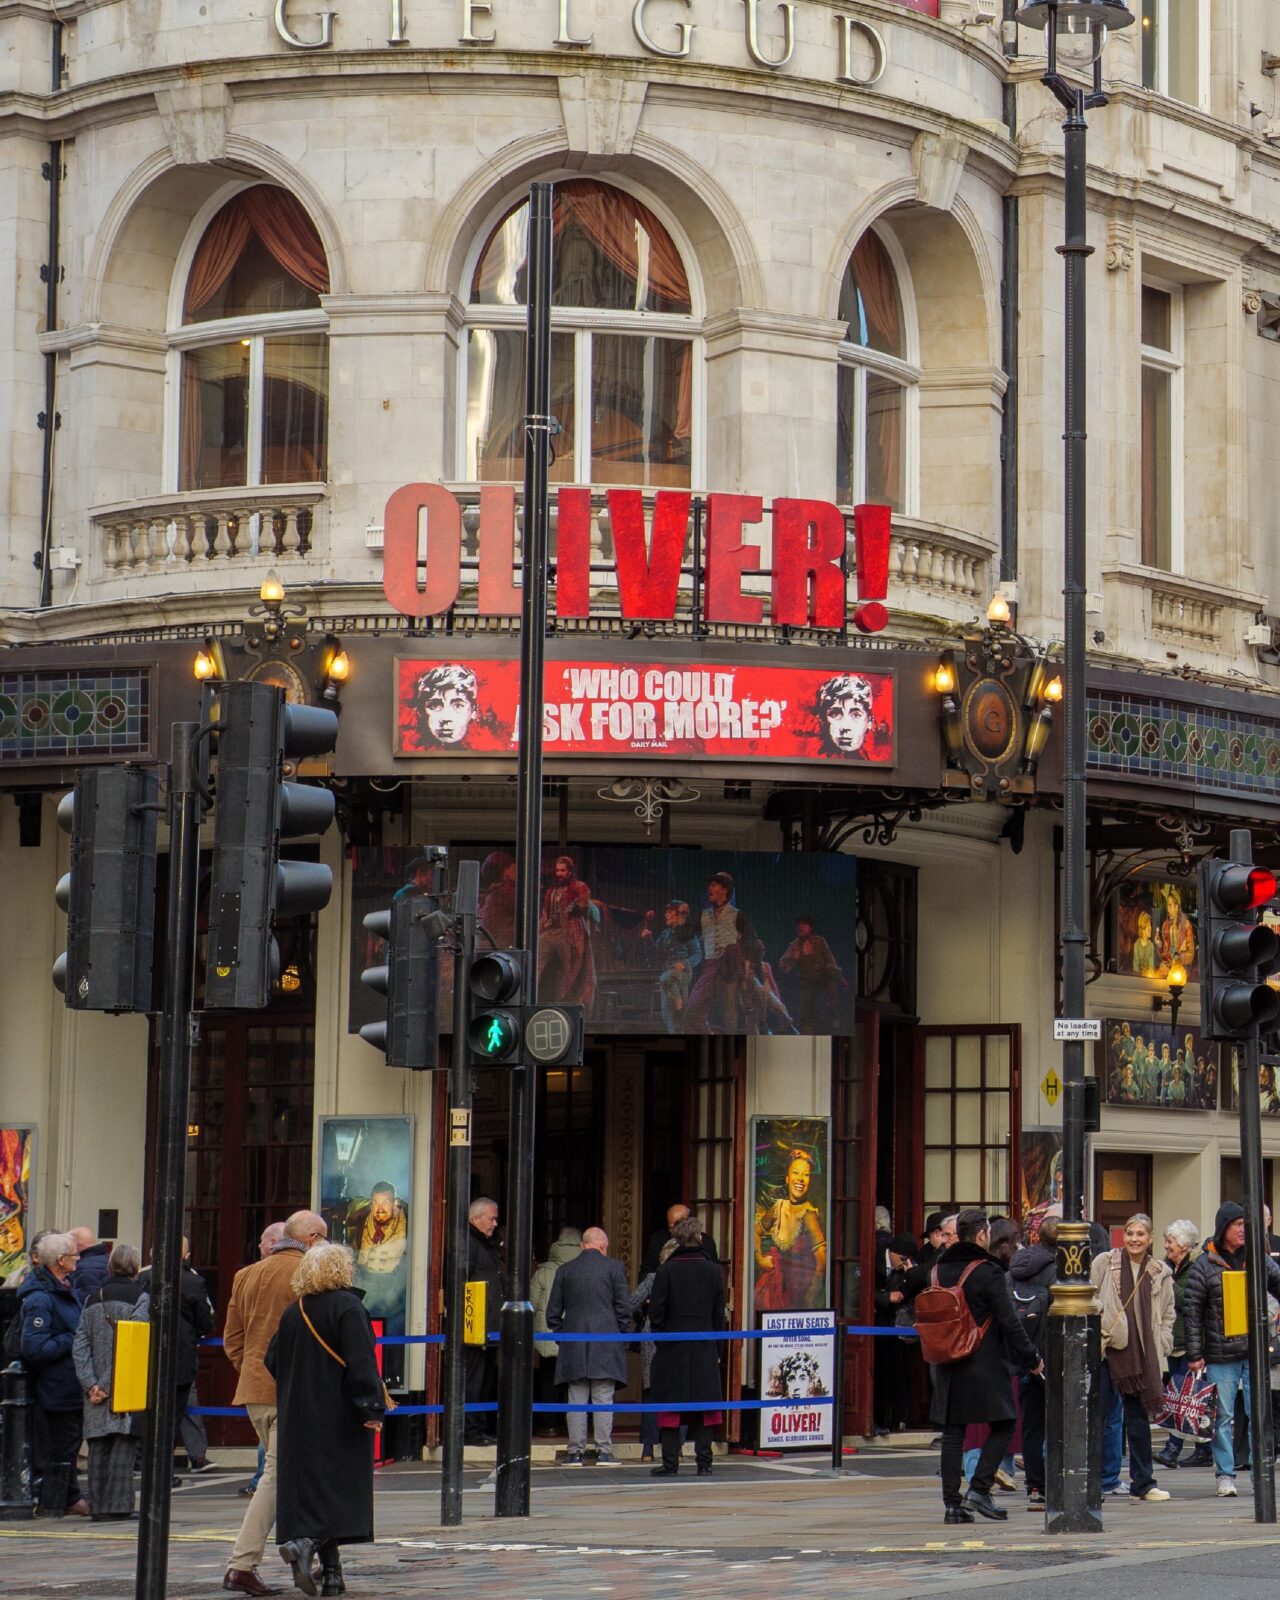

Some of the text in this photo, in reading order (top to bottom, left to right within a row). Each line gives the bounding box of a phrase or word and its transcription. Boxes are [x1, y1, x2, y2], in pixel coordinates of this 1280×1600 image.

[273, 0, 888, 85] GIELGUD
[384, 482, 892, 634] OLIVER!
[644, 670, 735, 703] COULD
[511, 702, 585, 742] SK
[591, 702, 656, 741] FOR
[1070, 1022, 1097, 1030] loading
[767, 1317, 829, 1330] LAST FEW SEATS
[771, 1412, 821, 1435] OLIVER!
